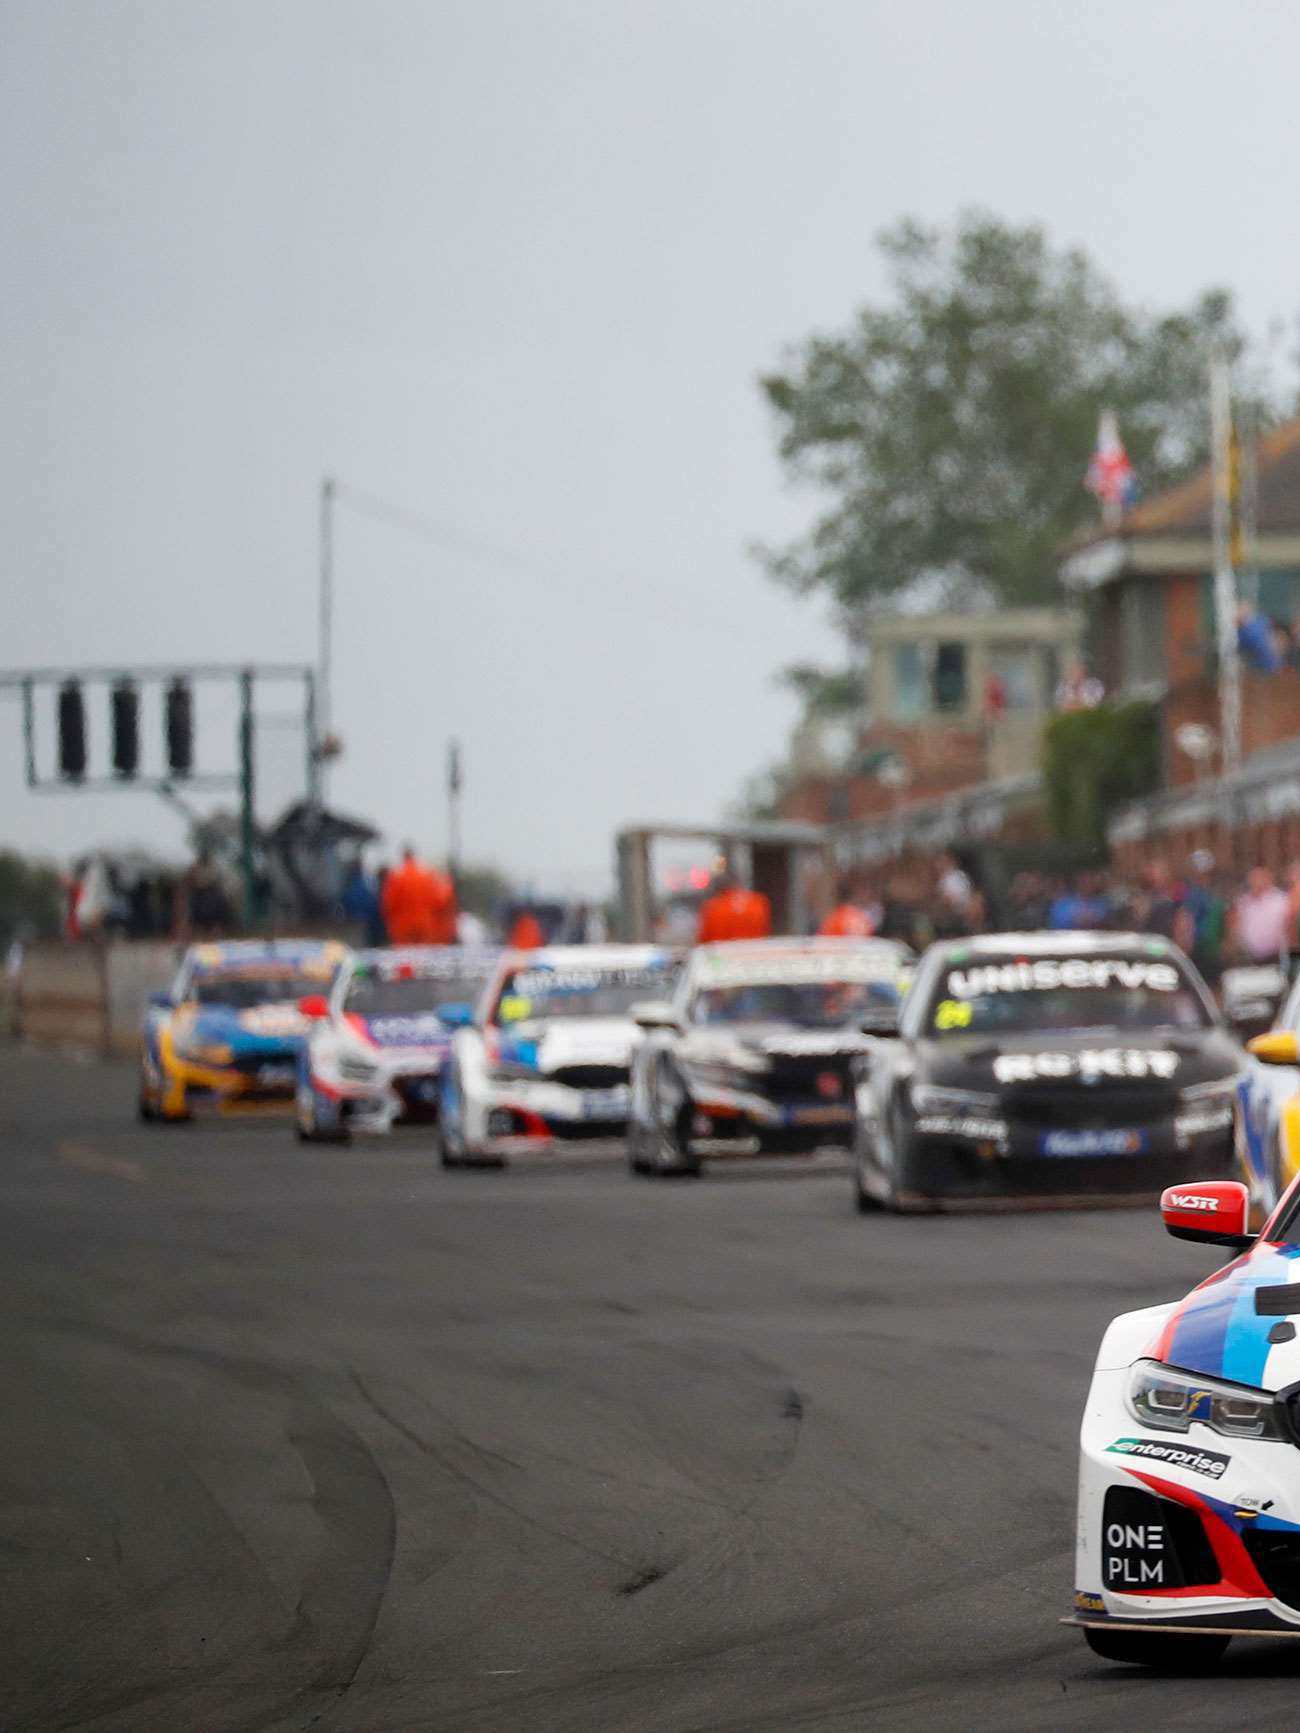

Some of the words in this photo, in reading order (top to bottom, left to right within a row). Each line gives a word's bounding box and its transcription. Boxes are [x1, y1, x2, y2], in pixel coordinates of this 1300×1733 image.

[1169, 1194, 1220, 1210] WSR
[1113, 1441, 1227, 1474] enterprise
[1107, 1524, 1164, 1549] ONE
[1108, 1557, 1164, 1583] PLM
